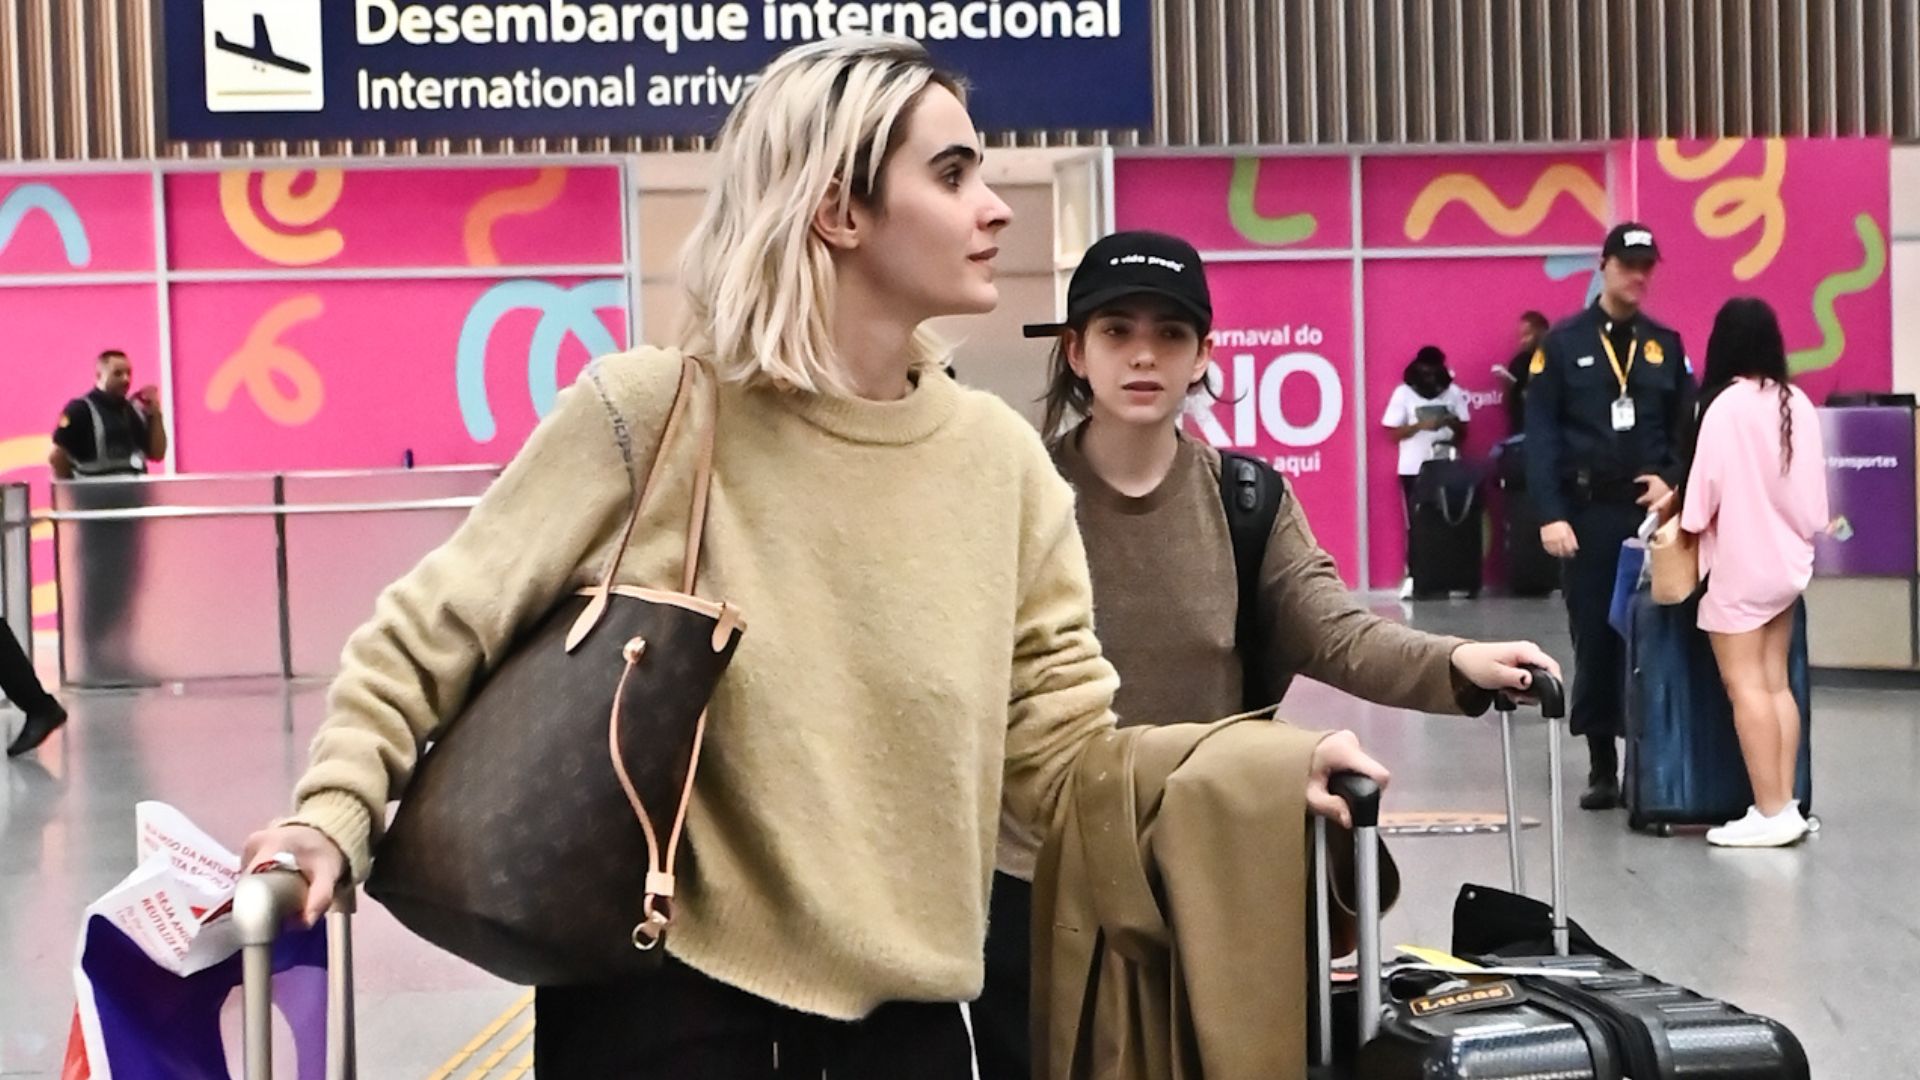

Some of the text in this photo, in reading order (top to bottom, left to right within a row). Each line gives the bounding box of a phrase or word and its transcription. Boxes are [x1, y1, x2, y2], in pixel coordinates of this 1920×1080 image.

[355, 0, 1121, 54] Desembarque internacional
[358, 65, 759, 110] International arriv
[1211, 325, 1323, 347] arnaval do
[1273, 450, 1321, 477] aqui
[199, 855, 238, 880] NATURE
